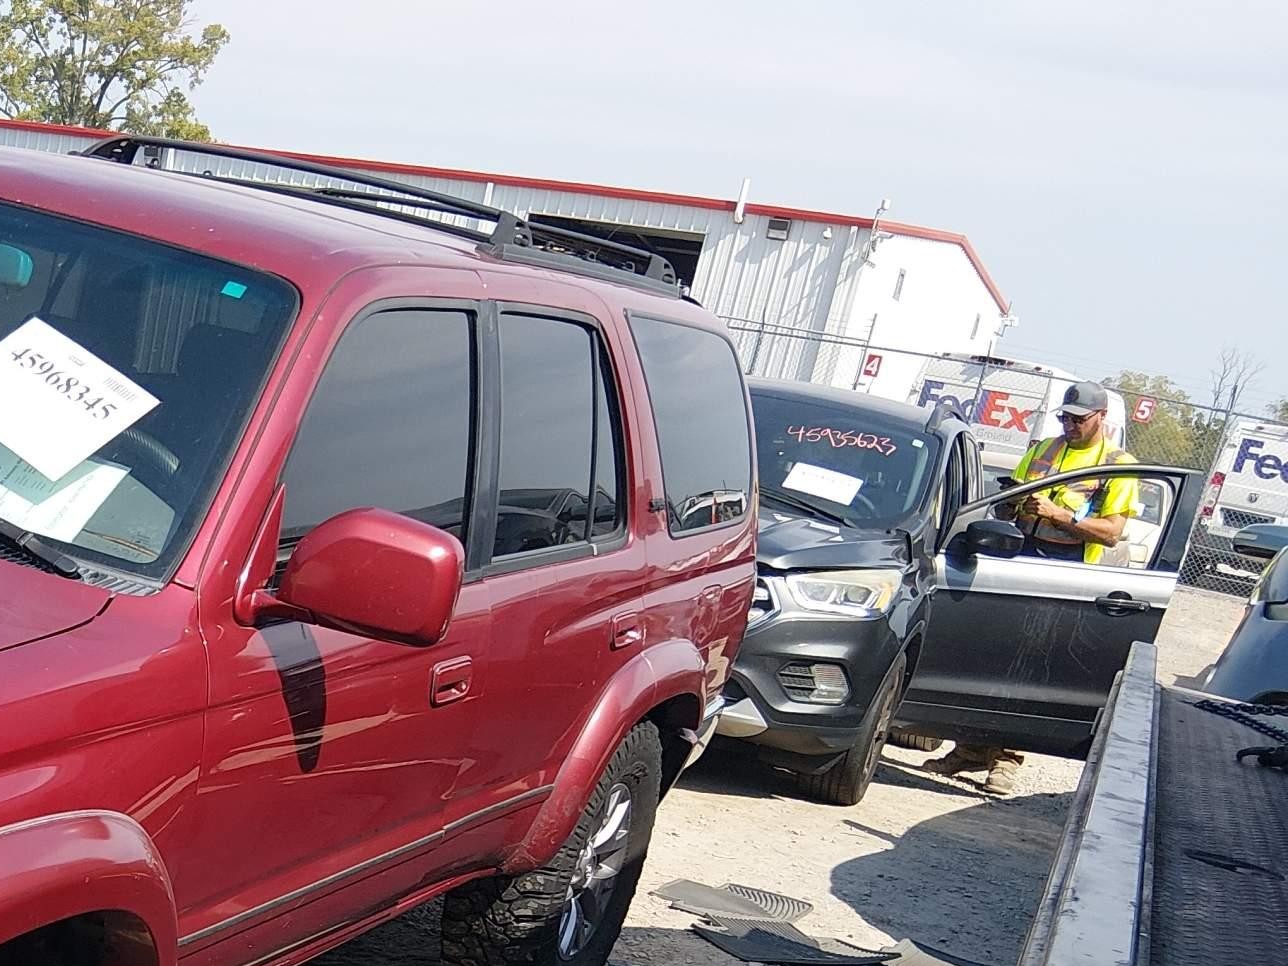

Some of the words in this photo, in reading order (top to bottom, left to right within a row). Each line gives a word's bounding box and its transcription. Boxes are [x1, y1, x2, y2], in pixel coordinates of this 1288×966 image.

[865, 356, 880, 376] 4
[12, 348, 118, 420] 45968345
[1134, 400, 1153, 420] 5
[787, 425, 896, 456] 45935623
